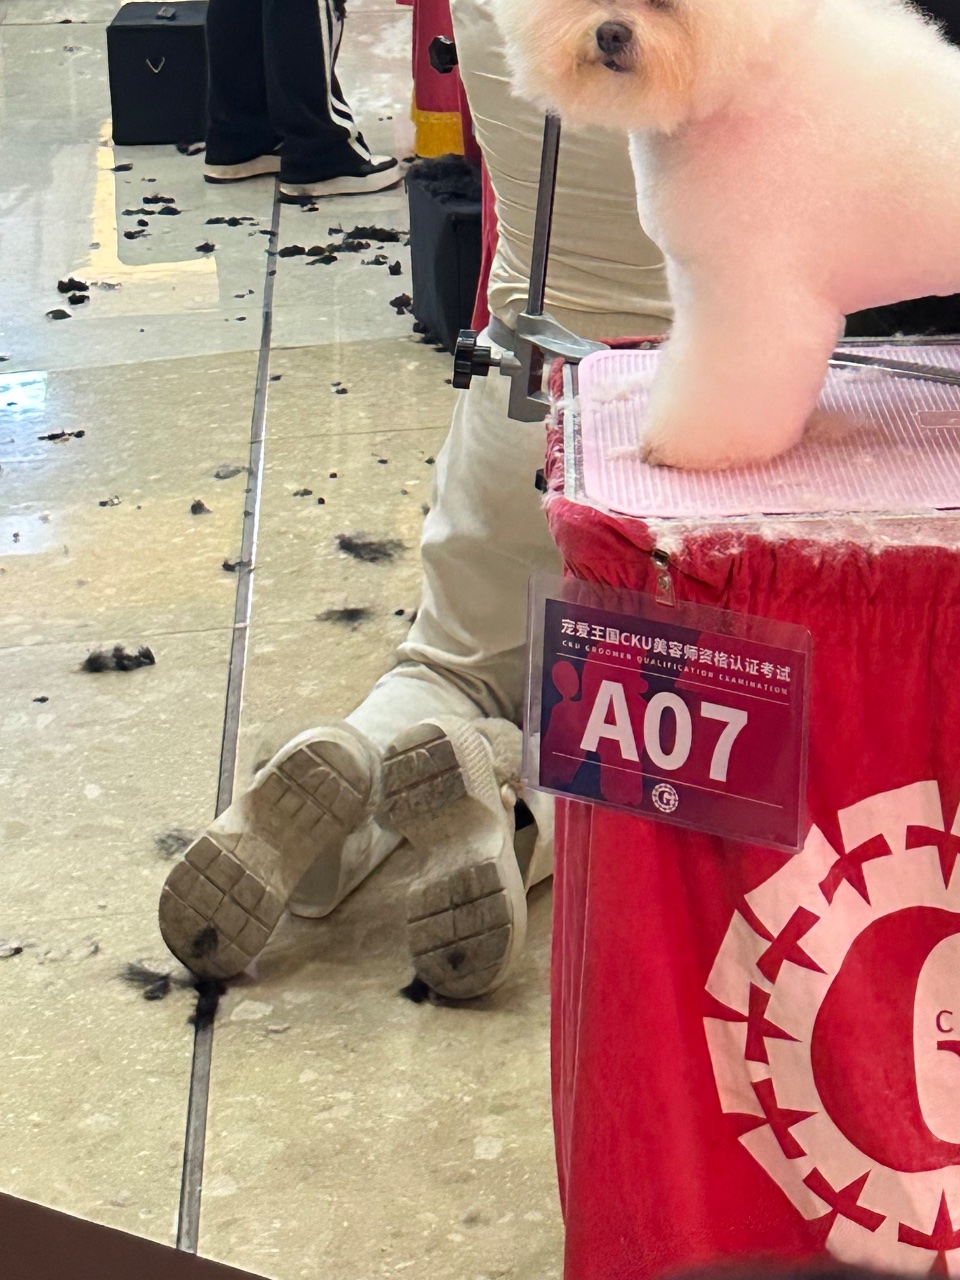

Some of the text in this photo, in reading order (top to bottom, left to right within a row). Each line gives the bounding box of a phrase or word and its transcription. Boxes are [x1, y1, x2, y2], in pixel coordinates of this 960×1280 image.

[561, 618, 792, 683] 宠爱王国CKU美容师资格认证考试
[562, 639, 788, 696] CKU GROOMER QUALIFICATION EXAMINATION
[579, 679, 748, 783] A07
